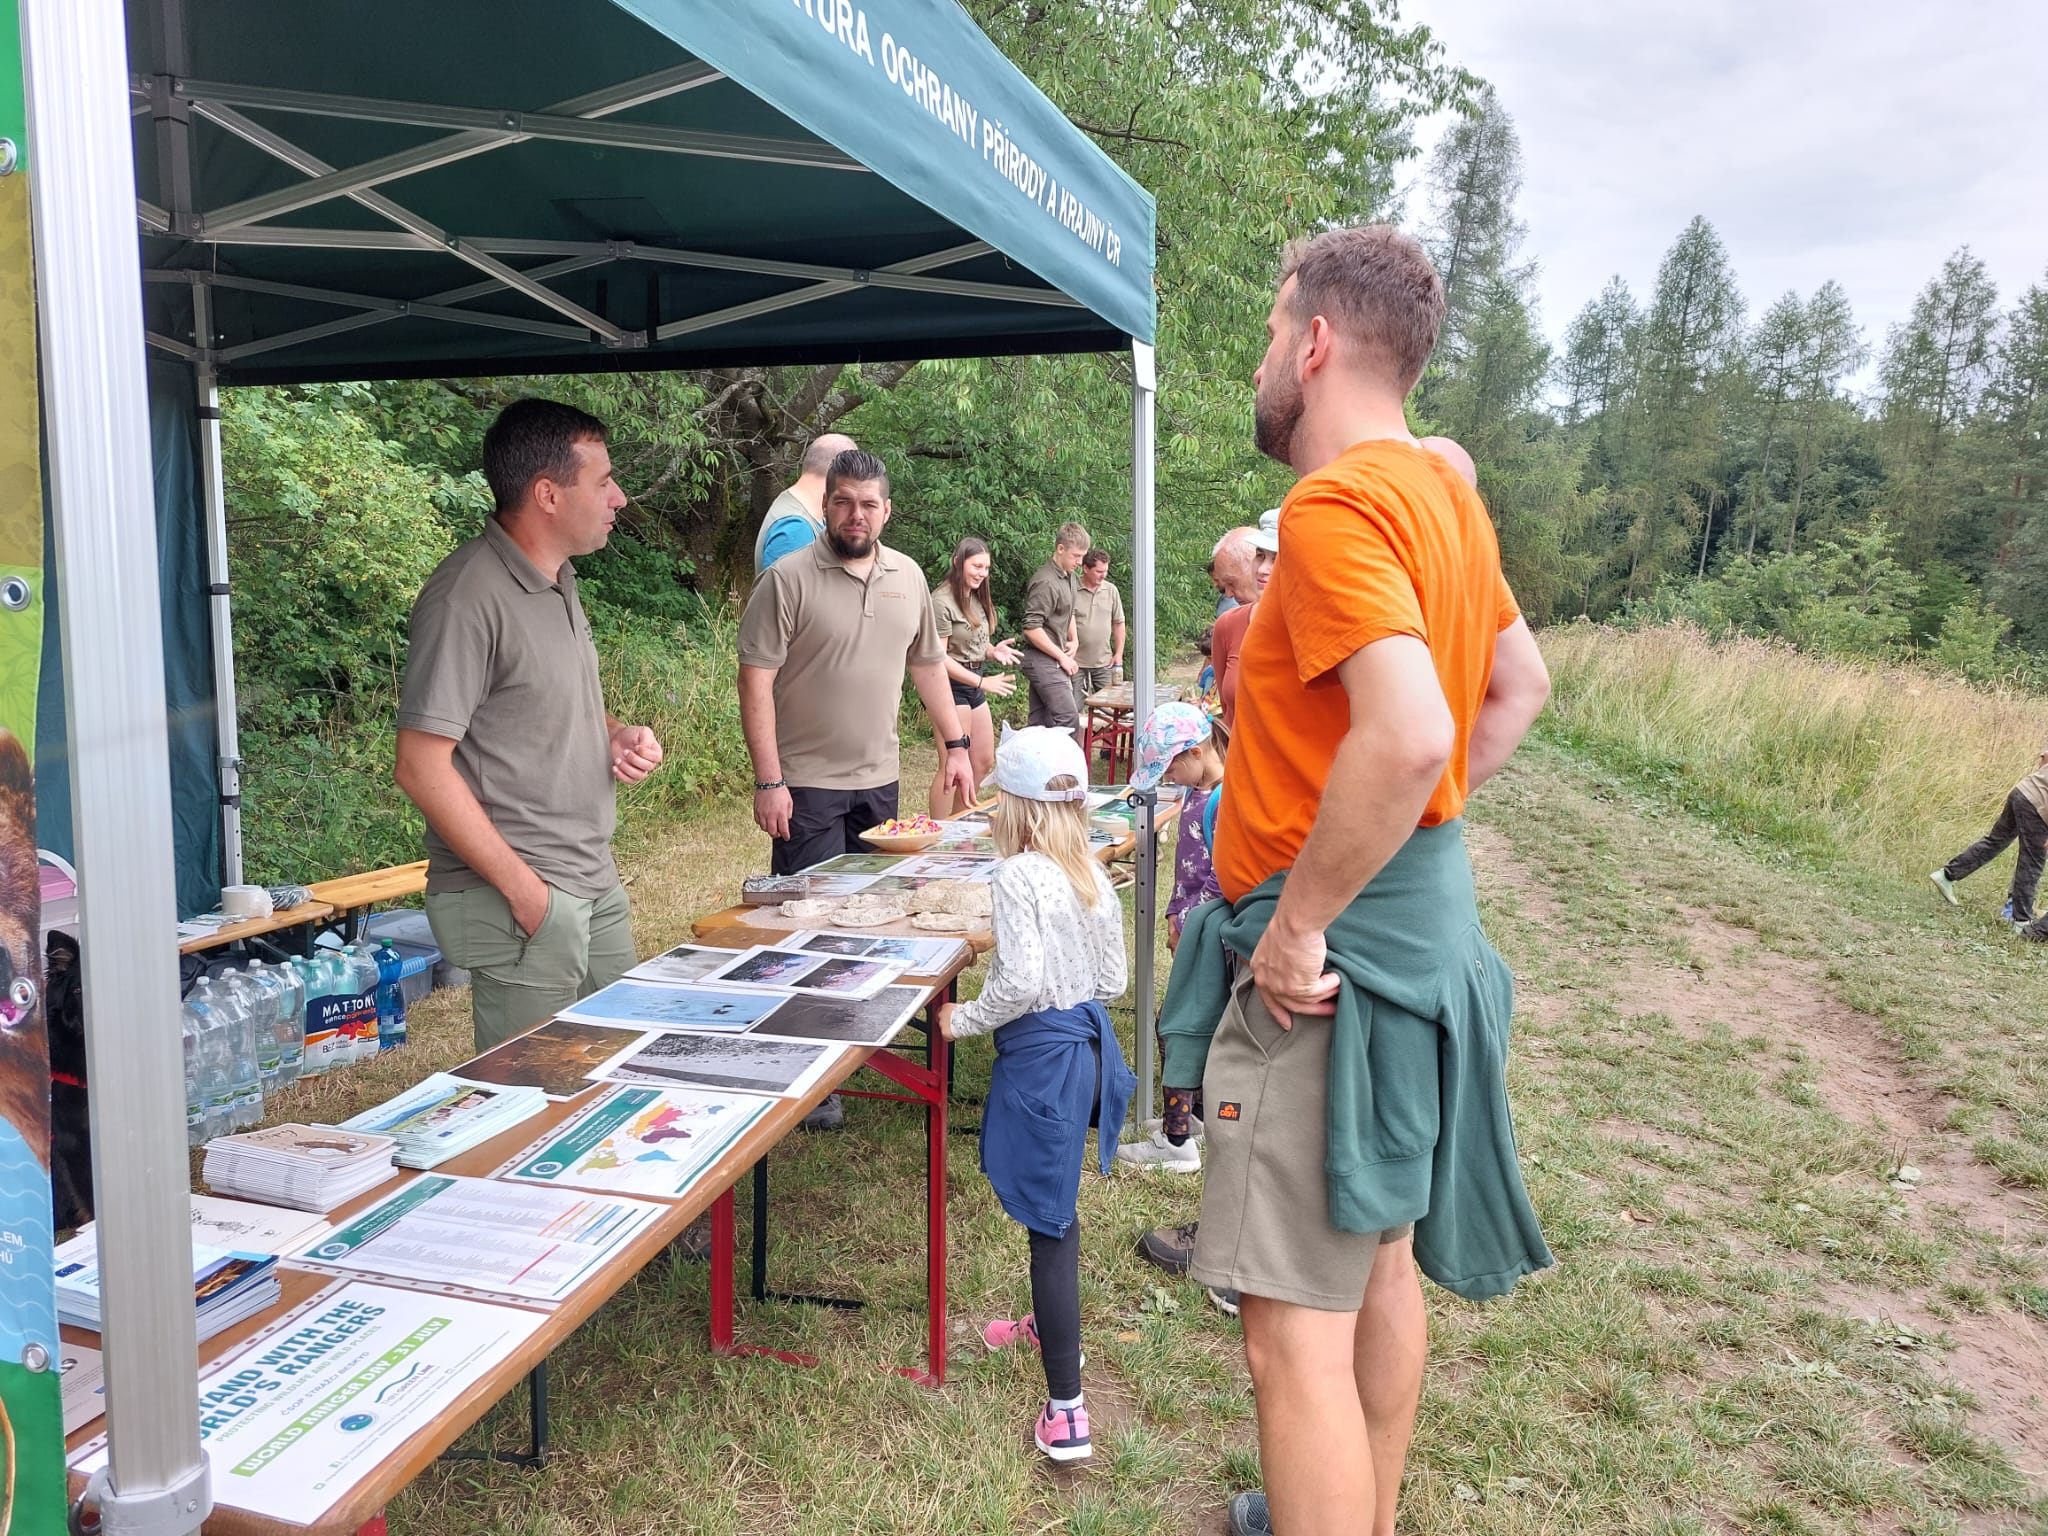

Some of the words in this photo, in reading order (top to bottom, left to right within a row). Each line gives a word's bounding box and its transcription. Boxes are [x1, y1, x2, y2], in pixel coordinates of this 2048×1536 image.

[881, 32, 978, 149] OCHRANY
[983, 118, 1048, 207] PŘÍRODY
[1046, 178, 1057, 217] A
[1058, 187, 1106, 254] KRAJINY
[1106, 222, 1122, 267] ČR
[0, 1231, 26, 1248] EM,
[200, 1369, 263, 1416] TAND
[255, 1328, 317, 1365] WITH
[314, 1299, 366, 1325] THE
[216, 1401, 275, 1442] PROTECTING
[271, 1374, 314, 1402] WILDLIFE
[312, 1362, 332, 1377] AND
[328, 1346, 353, 1364] WILD
[348, 1325, 382, 1349] PLACES
[241, 1426, 301, 1471] WORLD
[303, 1383, 364, 1425] RANGER
[362, 1360, 391, 1387] DAY
[396, 1340, 417, 1356] 31
[416, 1319, 443, 1341] JULY
[275, 1304, 387, 1375] RANGERS
